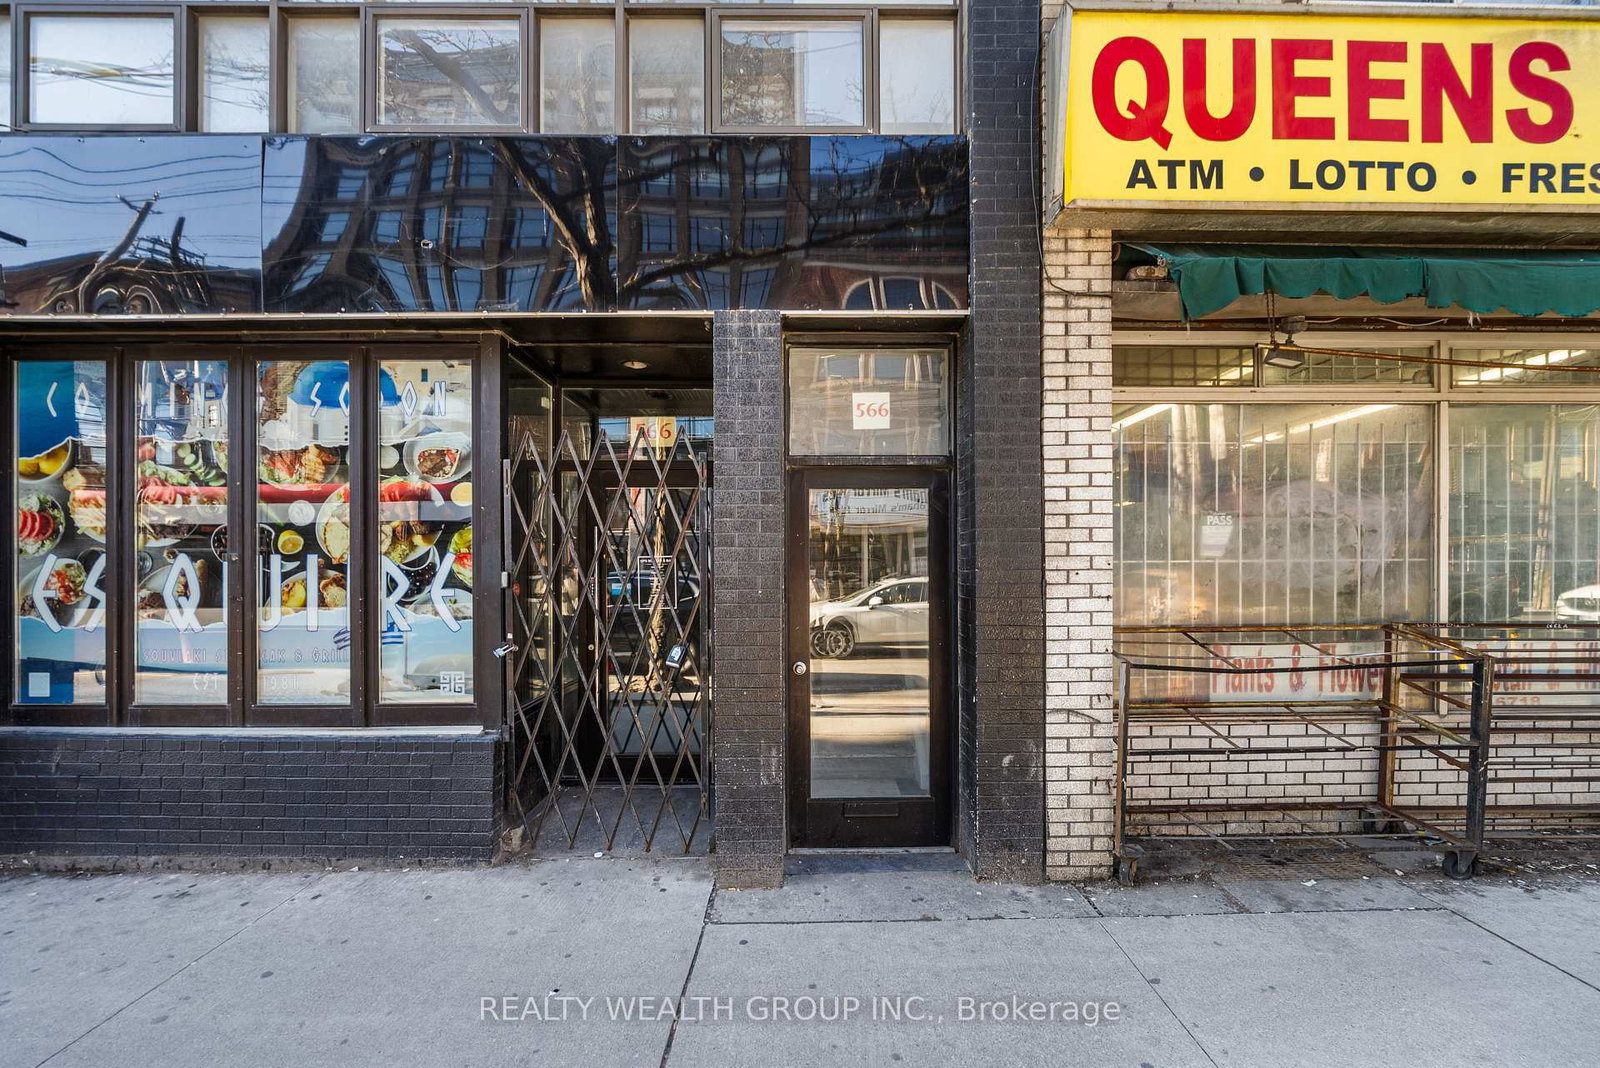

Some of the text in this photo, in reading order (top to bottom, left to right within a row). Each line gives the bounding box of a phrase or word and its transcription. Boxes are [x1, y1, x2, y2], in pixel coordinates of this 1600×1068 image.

[1092, 36, 1574, 150] QUEENS
[1126, 159, 1224, 190] ATM
[1289, 160, 1437, 191] LOTTO
[856, 402, 889, 417] 566
[1207, 515, 1233, 526] PASS
[32, 552, 462, 634] ESQUIRE
[1211, 643, 1275, 694] Plants
